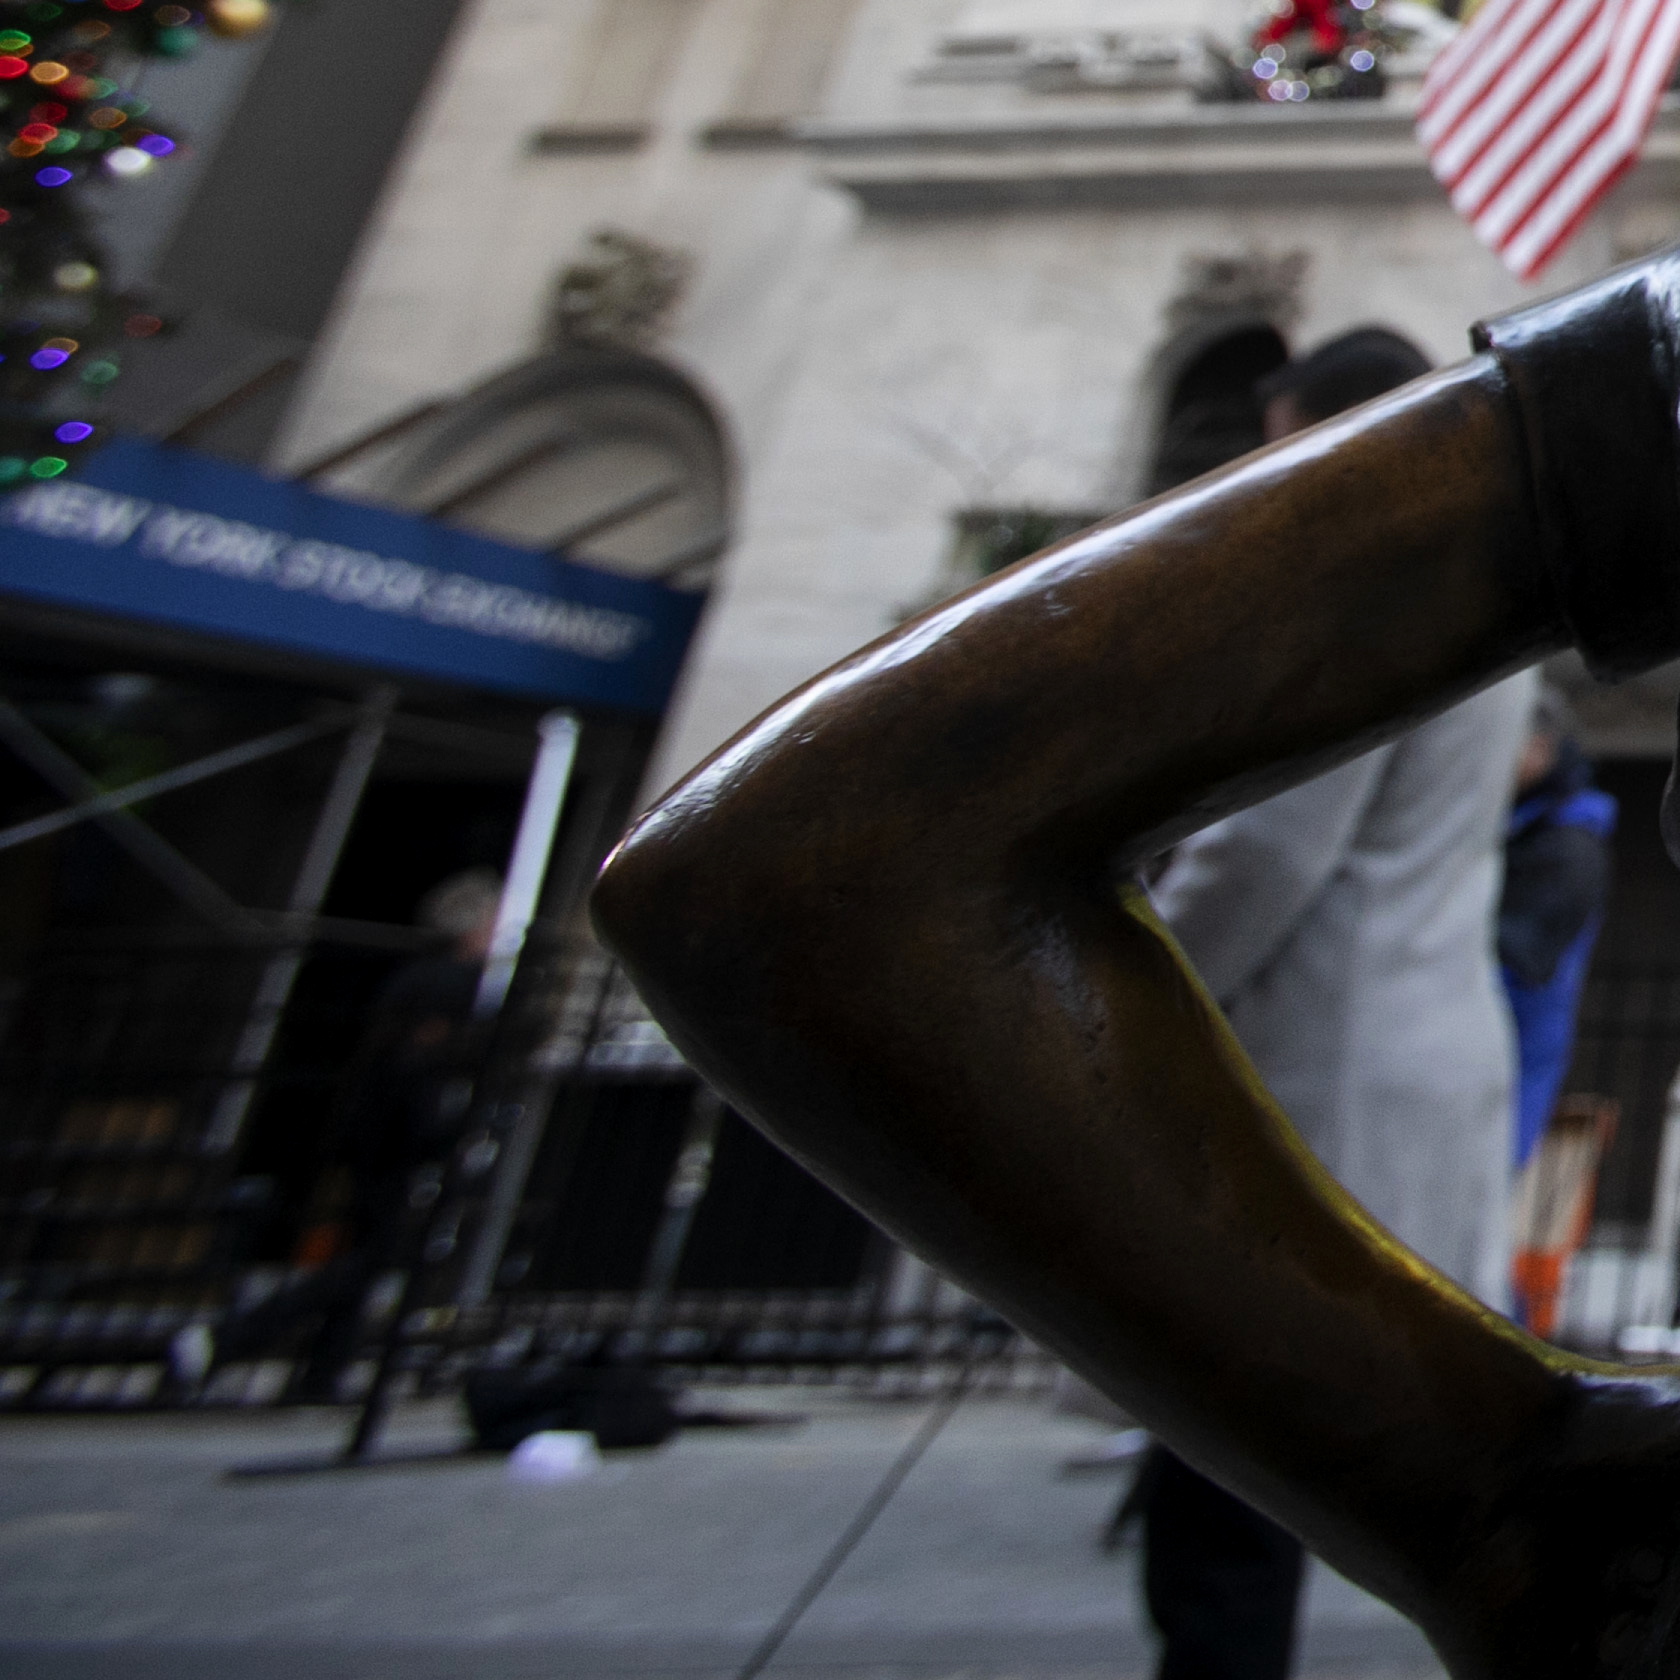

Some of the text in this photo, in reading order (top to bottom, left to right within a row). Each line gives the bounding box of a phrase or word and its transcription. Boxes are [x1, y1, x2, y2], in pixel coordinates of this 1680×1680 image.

[6, 480, 152, 550] NEW
[138, 502, 296, 584] YORK
[276, 536, 440, 618] STOCK
